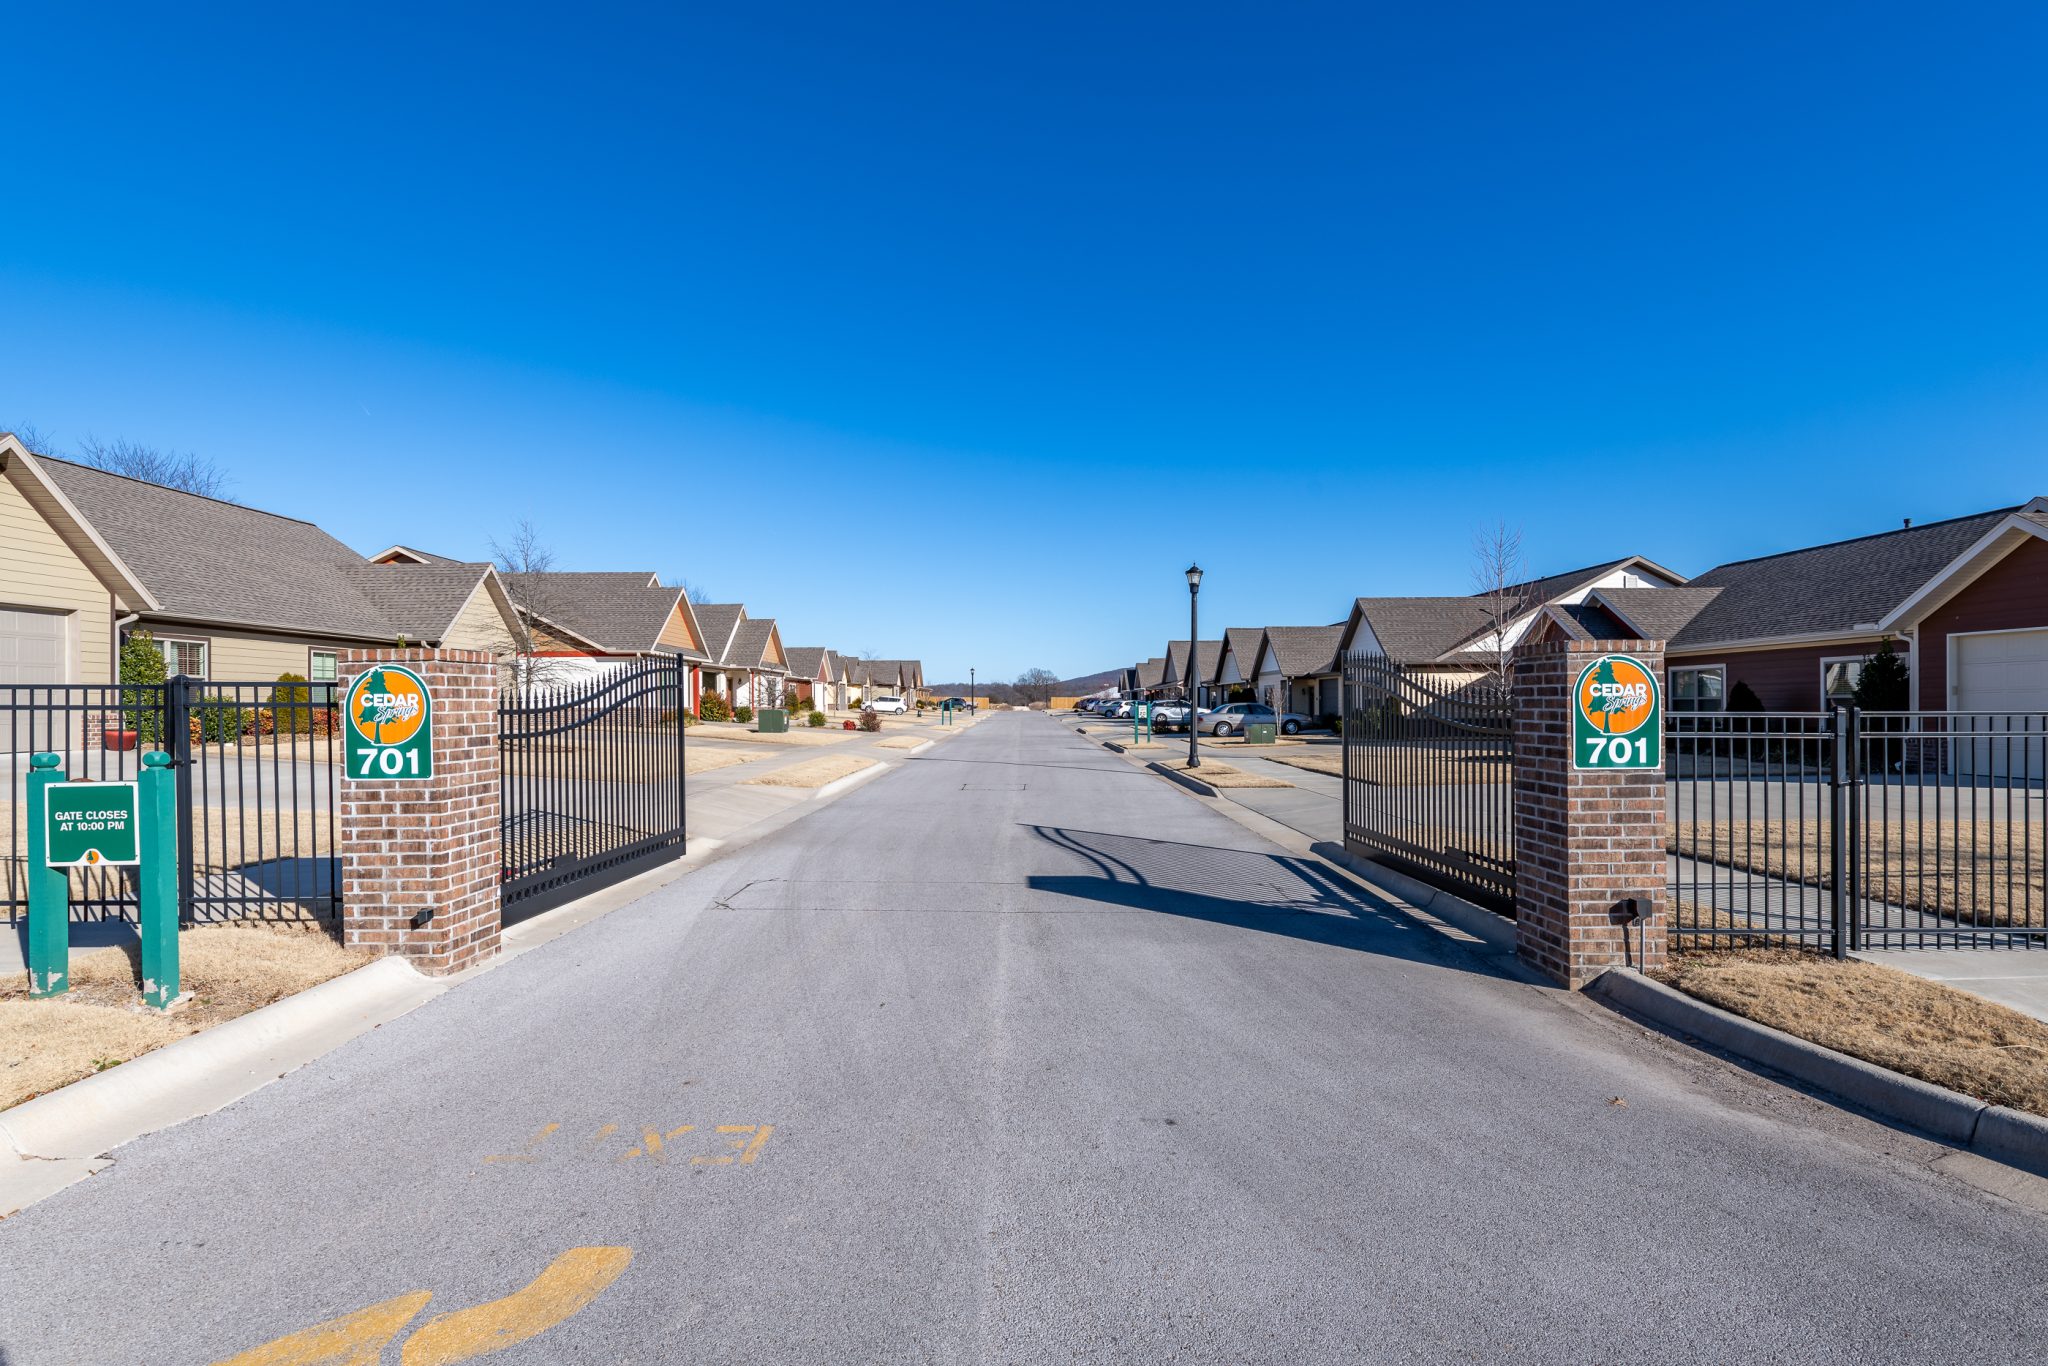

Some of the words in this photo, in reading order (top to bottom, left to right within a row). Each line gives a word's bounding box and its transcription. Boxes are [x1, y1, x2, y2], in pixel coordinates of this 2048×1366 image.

[1589, 683, 1647, 697] CEDAR
[360, 693, 419, 707] CEDAR
[1602, 694, 1648, 714] Springs
[373, 705, 419, 725] Springs
[1586, 737, 1647, 764] 701
[357, 748, 419, 775] 701
[55, 811, 83, 821] GATE
[86, 810, 128, 820] CLOSES
[60, 822, 74, 831] AT
[77, 821, 104, 831] 10:00
[107, 821, 125, 830] PM
